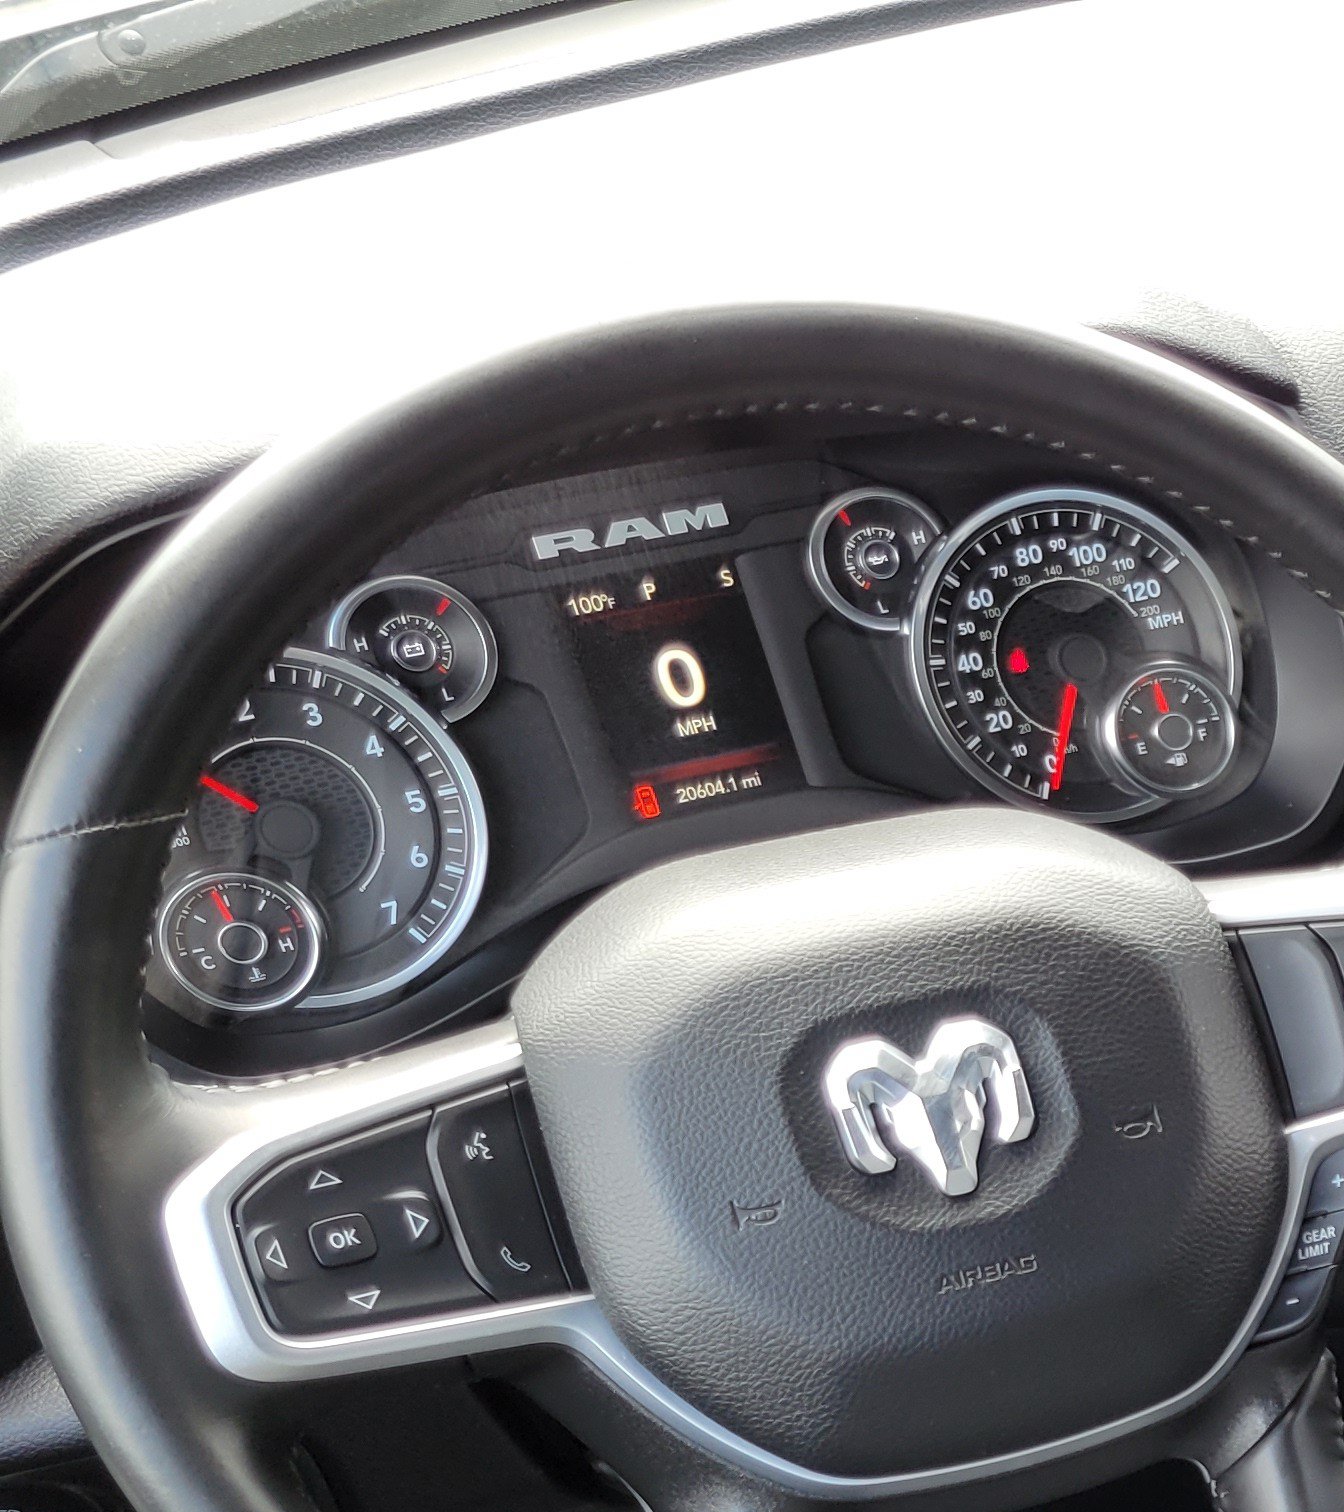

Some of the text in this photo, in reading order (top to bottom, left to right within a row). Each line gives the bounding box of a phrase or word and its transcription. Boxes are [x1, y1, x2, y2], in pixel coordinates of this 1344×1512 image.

[532, 502, 729, 560] RAM
[912, 529, 926, 545] H
[1050, 538, 1067, 553] 90
[1015, 545, 1043, 567] 80
[1069, 542, 1107, 567] 100
[990, 565, 1009, 580] 70
[1043, 564, 1063, 577] 140
[1081, 565, 1100, 578] 160
[1112, 557, 1136, 572] 110
[720, 570, 734, 587] S
[1012, 574, 1031, 587] 120
[1106, 574, 1126, 588] 180
[642, 583, 657, 601] P
[968, 589, 994, 610] 60
[1121, 579, 1161, 603] 120
[983, 607, 1001, 620] 100
[1140, 604, 1160, 618] 200
[958, 622, 976, 636] 50
[1148, 611, 1185, 631] MPH
[979, 629, 992, 642] 80
[353, 637, 367, 653] H
[958, 652, 983, 672] 40
[657, 649, 707, 707] 0
[981, 667, 994, 679] 60
[967, 689, 985, 704] 30
[994, 696, 1007, 708] 40
[302, 702, 322, 727] 3
[985, 711, 1013, 733] 20
[677, 716, 717, 737] MPH
[1017, 722, 1031, 735] 20
[1198, 727, 1209, 742] F
[365, 734, 384, 758] 4
[1011, 744, 1028, 757] 10
[1137, 741, 1148, 755] E
[676, 772, 762, 803] 20604.1 mi
[405, 789, 426, 813] 5
[411, 845, 429, 869] 6
[381, 901, 398, 925] 7
[329, 1228, 361, 1249] OK
[1303, 1225, 1336, 1244] GEAR
[1298, 1242, 1330, 1259] LIMIT
[938, 1254, 1039, 1295] AIRBAG
